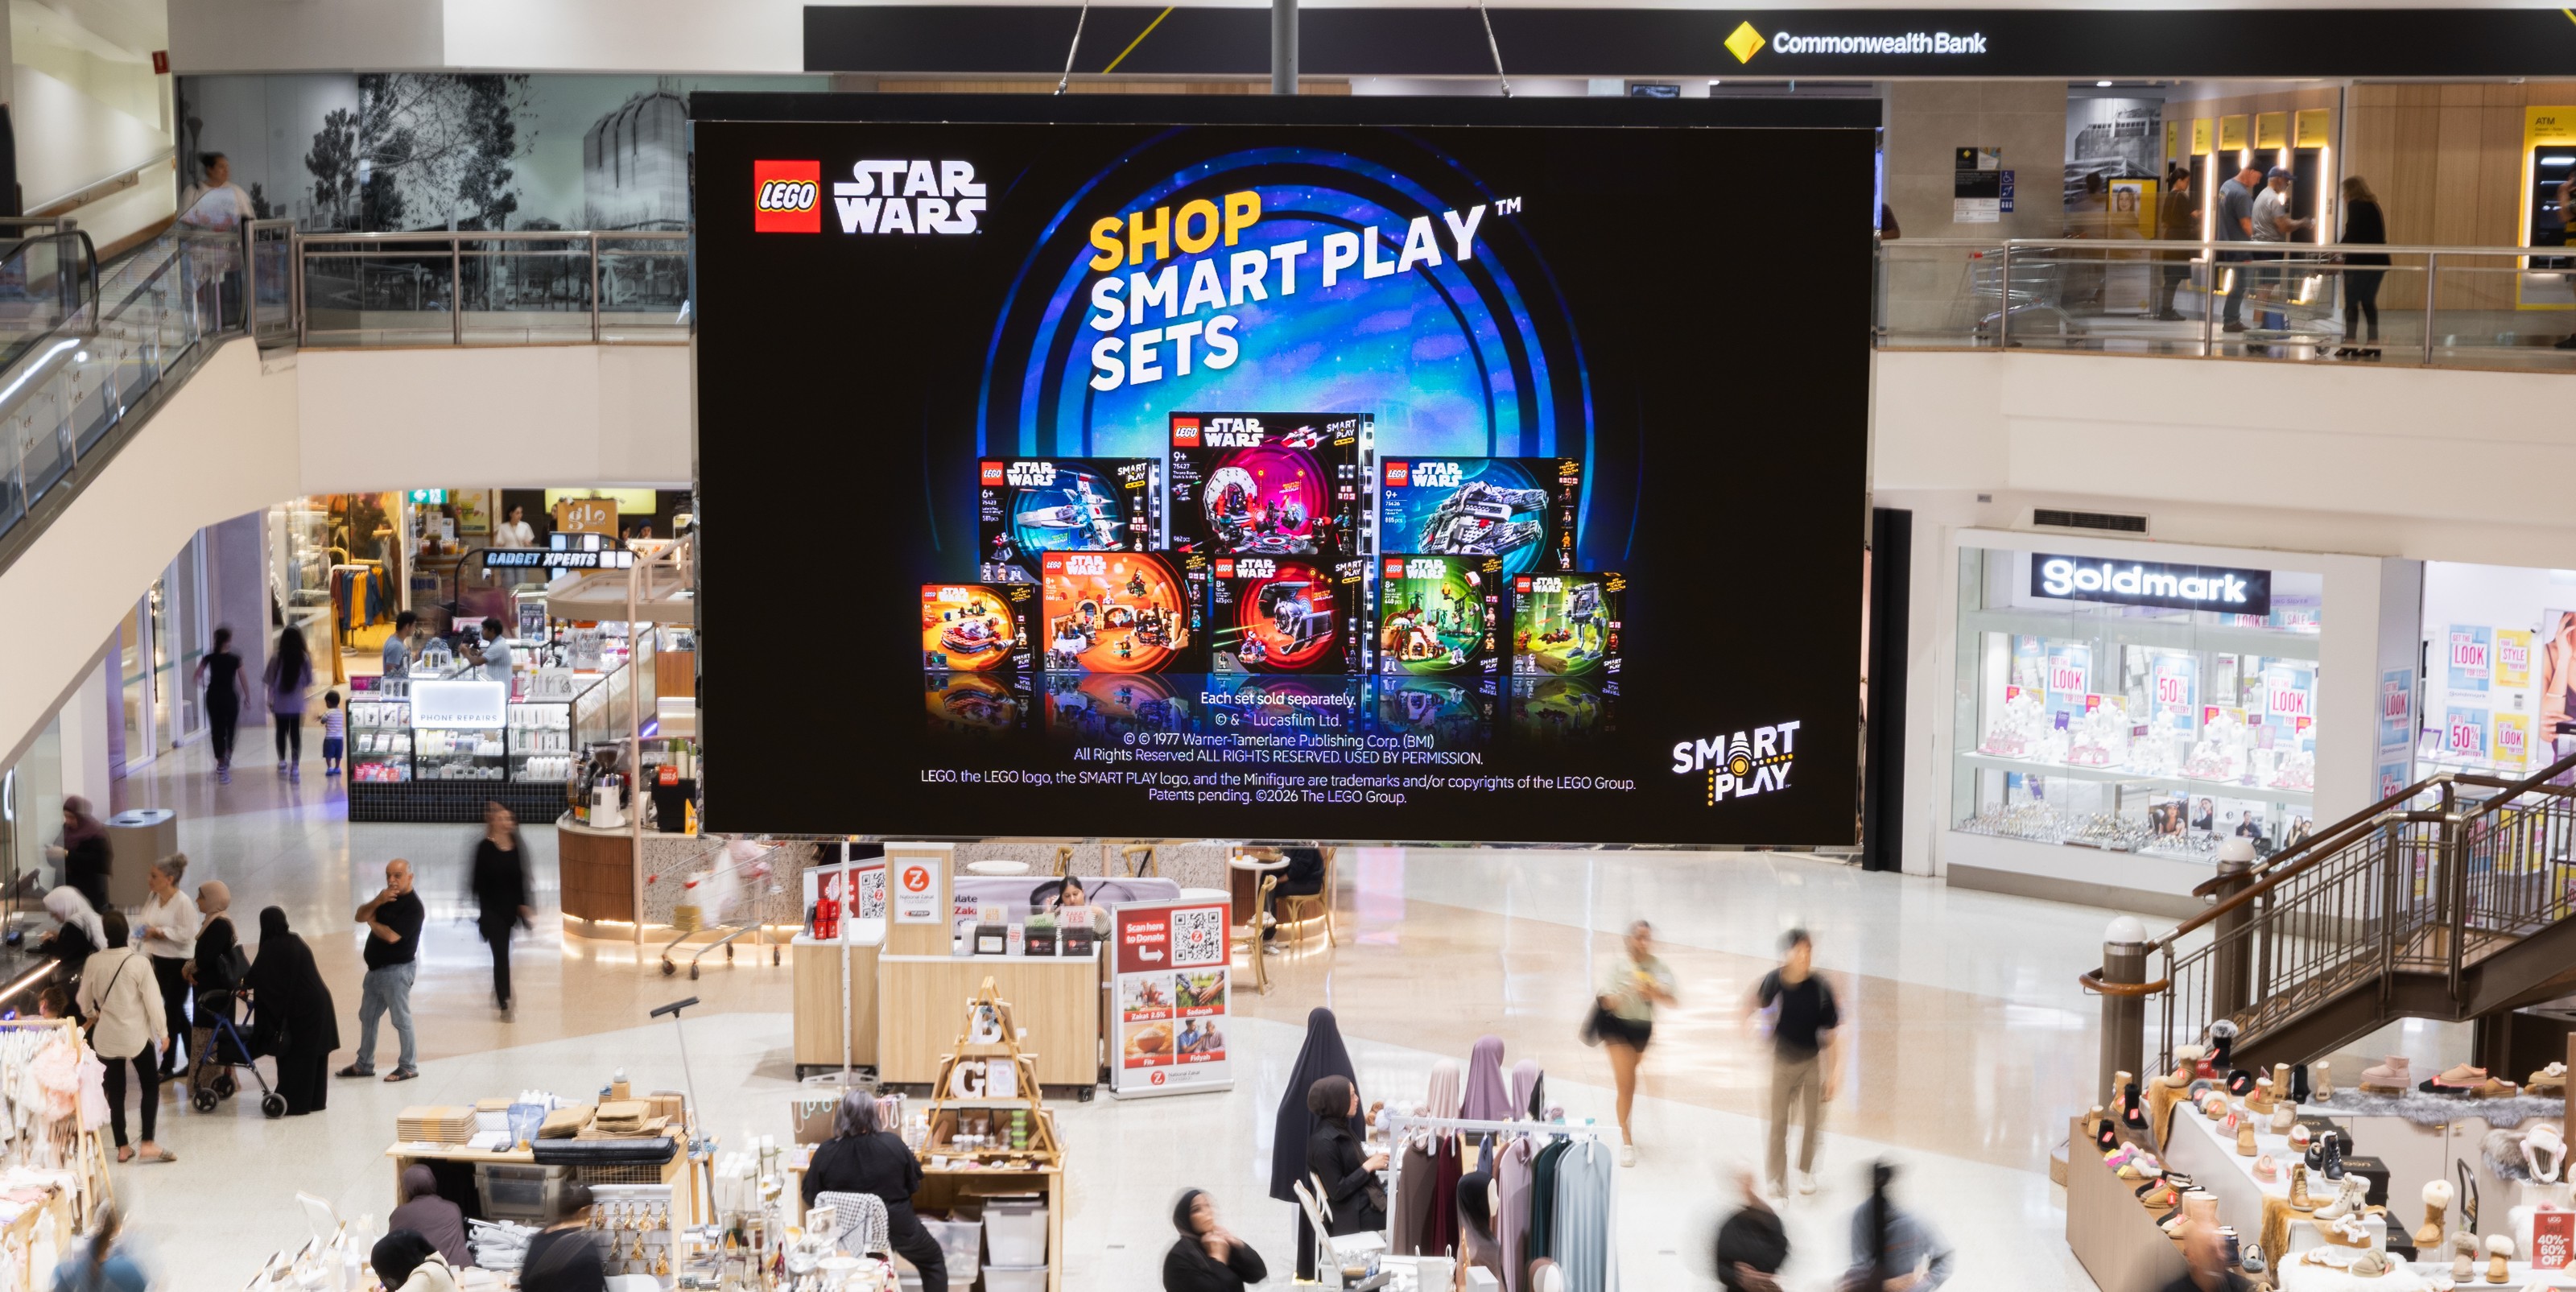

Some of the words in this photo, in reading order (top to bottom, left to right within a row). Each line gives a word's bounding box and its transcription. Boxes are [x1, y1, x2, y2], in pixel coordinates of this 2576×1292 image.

[2536, 117, 2555, 125] ATM
[833, 160, 986, 197] STAR
[759, 181, 818, 210] LEGO
[833, 197, 986, 234] WARS
[1089, 190, 1261, 272] SHOP
[1090, 241, 1308, 332] SMART
[1323, 204, 1487, 288] PLAY
[1089, 315, 1239, 392] SETS
[1175, 425, 1198, 438] LEGO
[1204, 418, 1264, 433] STAR
[1327, 419, 1356, 433] SMART
[1204, 432, 1264, 448] WARS
[1336, 428, 1355, 440] PLAY
[1173, 451, 1187, 462] 9+
[983, 469, 1002, 478] LEGO
[1006, 461, 1056, 474] STAR
[1117, 462, 1147, 476] SMART
[1387, 469, 1407, 479] LEGO
[1412, 462, 1462, 475] STAR
[1006, 473, 1056, 486] WARS
[1127, 473, 1146, 482] PLAY
[1412, 475, 1462, 487] WARS
[982, 489, 994, 498] 6+
[1385, 490, 1397, 499] 9+
[487, 551, 541, 567] GADGET
[543, 552, 597, 567] XPERTS
[1066, 555, 1106, 565] STAR
[1236, 559, 1276, 568] STAR
[1335, 559, 1363, 572] SMART
[1406, 559, 1447, 569] STAR
[1066, 564, 1106, 576] WARS
[1236, 568, 1276, 578] WARS
[1344, 568, 1361, 578] PLAY
[1386, 563, 1402, 572] LEGO
[1406, 568, 1447, 579] WARS
[1533, 577, 1563, 586] STAR
[2042, 559, 2248, 603] goldmark
[2287, 614, 2306, 625] SALE
[2454, 645, 2484, 666] LOOK
[2503, 648, 2524, 661] STYLE
[2053, 668, 2083, 691] LOOK
[2467, 668, 2475, 677] FOR
[2476, 668, 2487, 678] LESS
[1201, 691, 1232, 704] Each
[1235, 692, 1254, 705] set
[1257, 691, 1285, 705] sold
[1287, 692, 1356, 709] separately.
[2273, 691, 2304, 713] LOOK
[2385, 693, 2406, 716] LOOK
[420, 714, 453, 722] PHONE
[456, 714, 497, 722] REPAIRS
[1230, 713, 1240, 726] &
[1253, 712, 1315, 727] Lucasfilm
[1319, 714, 1342, 727] Ltd.
[1153, 733, 1180, 745] 1977
[1182, 733, 1296, 747] Warner-Tamerlane
[1299, 733, 1364, 751] Publishing
[1367, 734, 1401, 750] Corp.
[1403, 733, 1435, 749] (BMI)
[2500, 731, 2522, 745] LOOK
[1672, 720, 1800, 774] SMART
[1074, 747, 1091, 761] All
[1093, 747, 1133, 764] Rights
[1135, 748, 1194, 762] Reserved
[1196, 749, 1220, 762] ALL
[1223, 749, 1270, 763] RIGHTS
[1273, 749, 1341, 763] RESERVED.
[1345, 750, 1380, 764] USED
[1383, 750, 1400, 764] BY
[1402, 751, 1484, 765] PERMISSION.
[960, 770, 981, 782] the
[985, 770, 1019, 783] LEGO
[1022, 770, 1053, 786] logo,
[1055, 770, 1076, 784] the
[1079, 770, 1124, 784] SMART
[1126, 772, 1158, 785] PLAY
[1160, 771, 1191, 788] logo,
[1193, 772, 1217, 785] and
[1220, 772, 1241, 786] the
[1244, 772, 1305, 790] Minifigure
[1307, 776, 1328, 786] are
[1331, 774, 1400, 787] trademarks
[1402, 774, 1446, 790] and/or
[1447, 775, 1514, 791] copyrights
[1517, 775, 1531, 789] of
[1533, 775, 1554, 789] the
[1557, 776, 1592, 790] LEGO
[1594, 776, 1637, 792] Group.
[1715, 762, 1792, 802] PLAY
[1149, 788, 1195, 801] Patents
[1198, 788, 1253, 805] pending.
[1300, 790, 1325, 803] The
[1327, 790, 1363, 803] LEGO
[1365, 790, 1407, 807] Group.
[1127, 923, 1146, 933] Scan
[1146, 922, 1164, 932] here
[1127, 935, 1136, 943] to
[1137, 933, 1165, 943] Donate
[1131, 1012, 1150, 1021] Zakat
[1150, 1010, 1166, 1019] 2.5%
[1190, 1054, 1211, 1063] Fidyah
[950, 1061, 985, 1100] G
[2544, 1225, 2564, 1233] SALE
[2541, 1245, 2566, 1255] 60%
[2541, 1255, 2564, 1265] OFF
